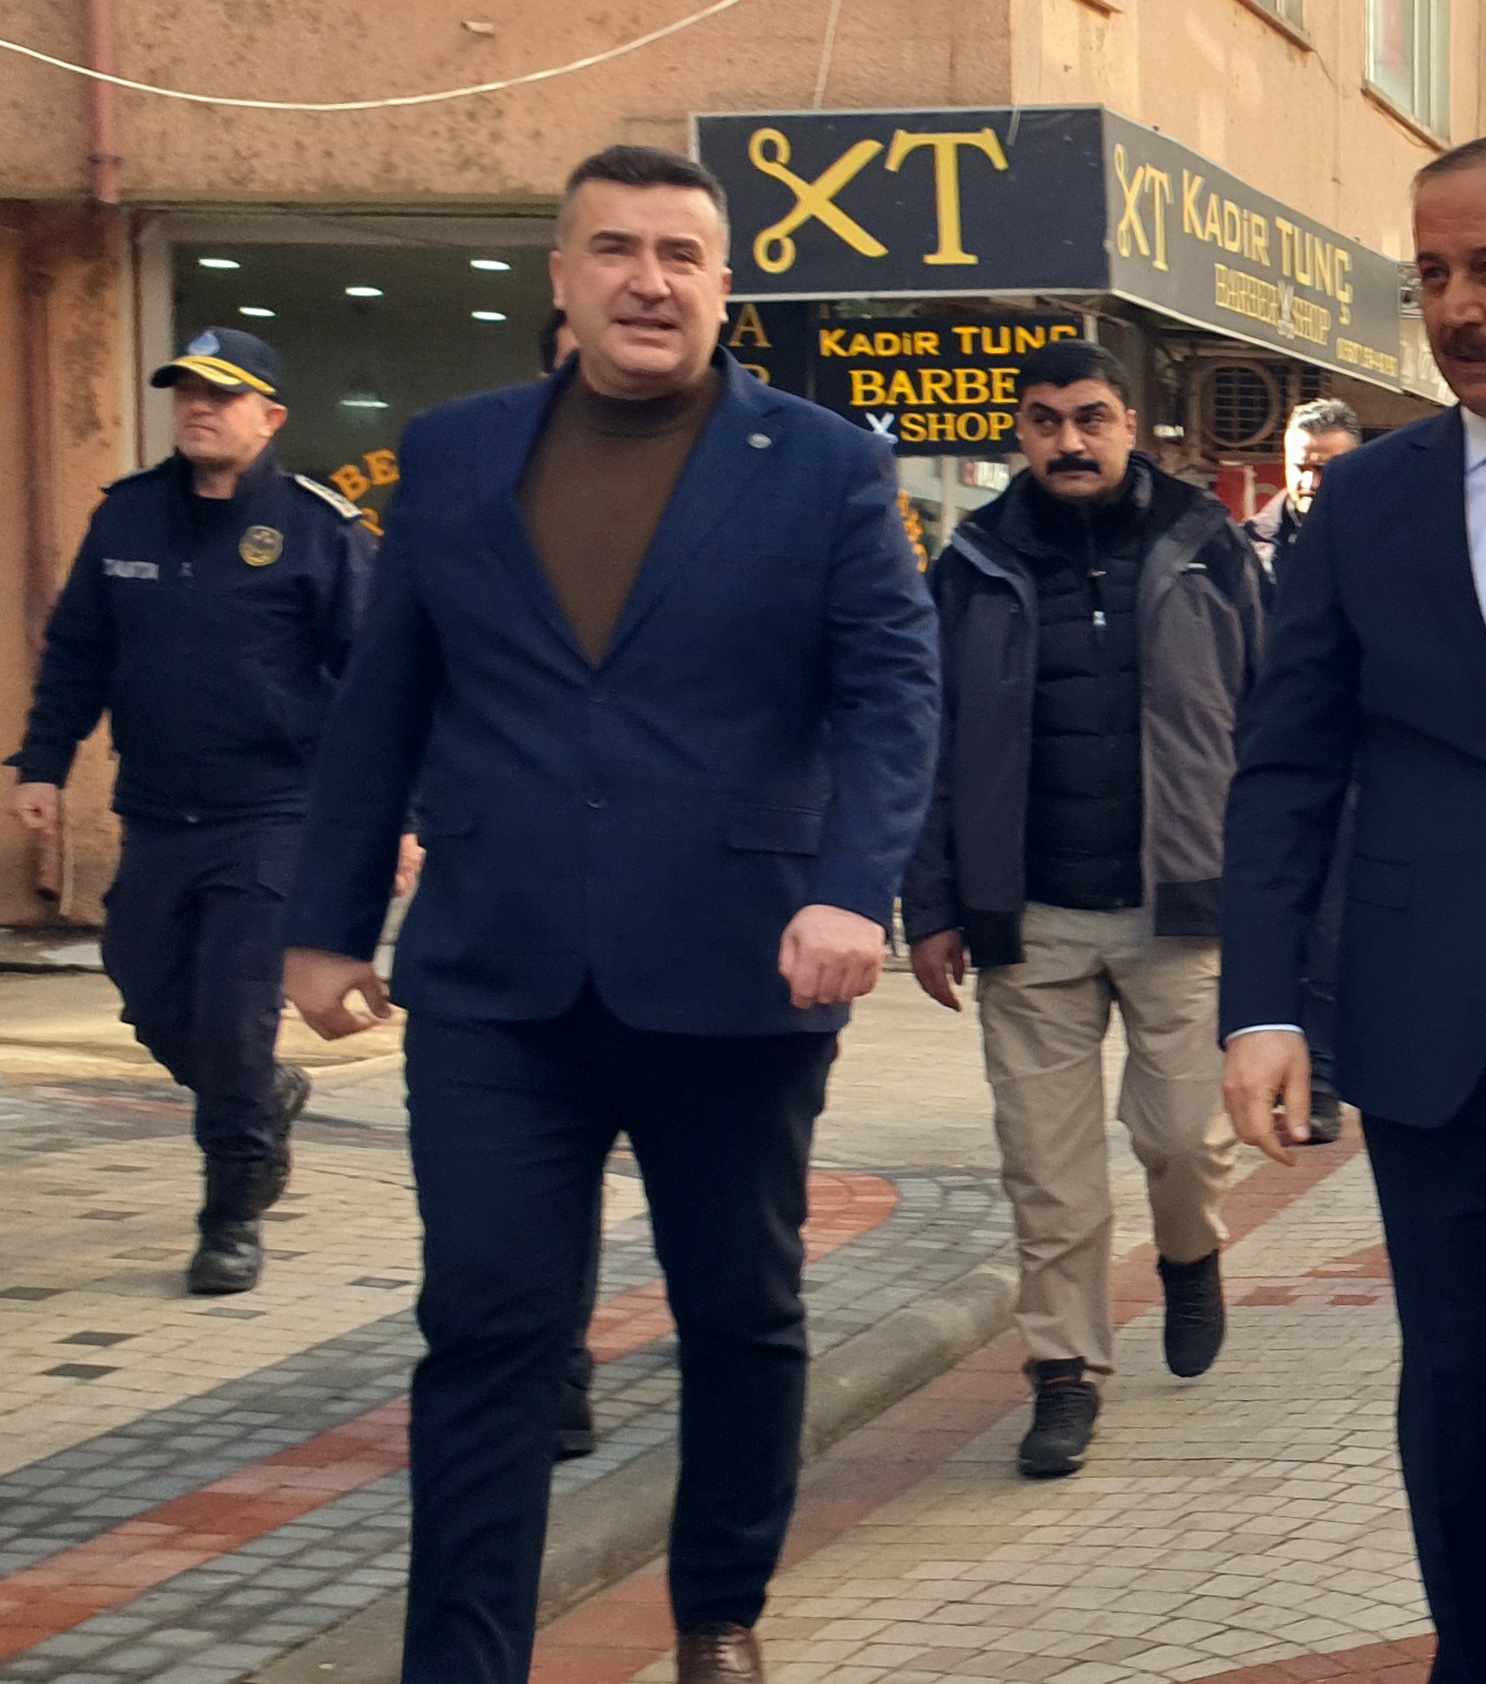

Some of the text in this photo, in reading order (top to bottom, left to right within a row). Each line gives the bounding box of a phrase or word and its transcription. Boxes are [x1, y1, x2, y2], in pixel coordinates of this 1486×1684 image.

[1275, 216, 1354, 325] TUNÇ
[849, 367, 1022, 407] BARBE
[900, 411, 1015, 443] SHOP
